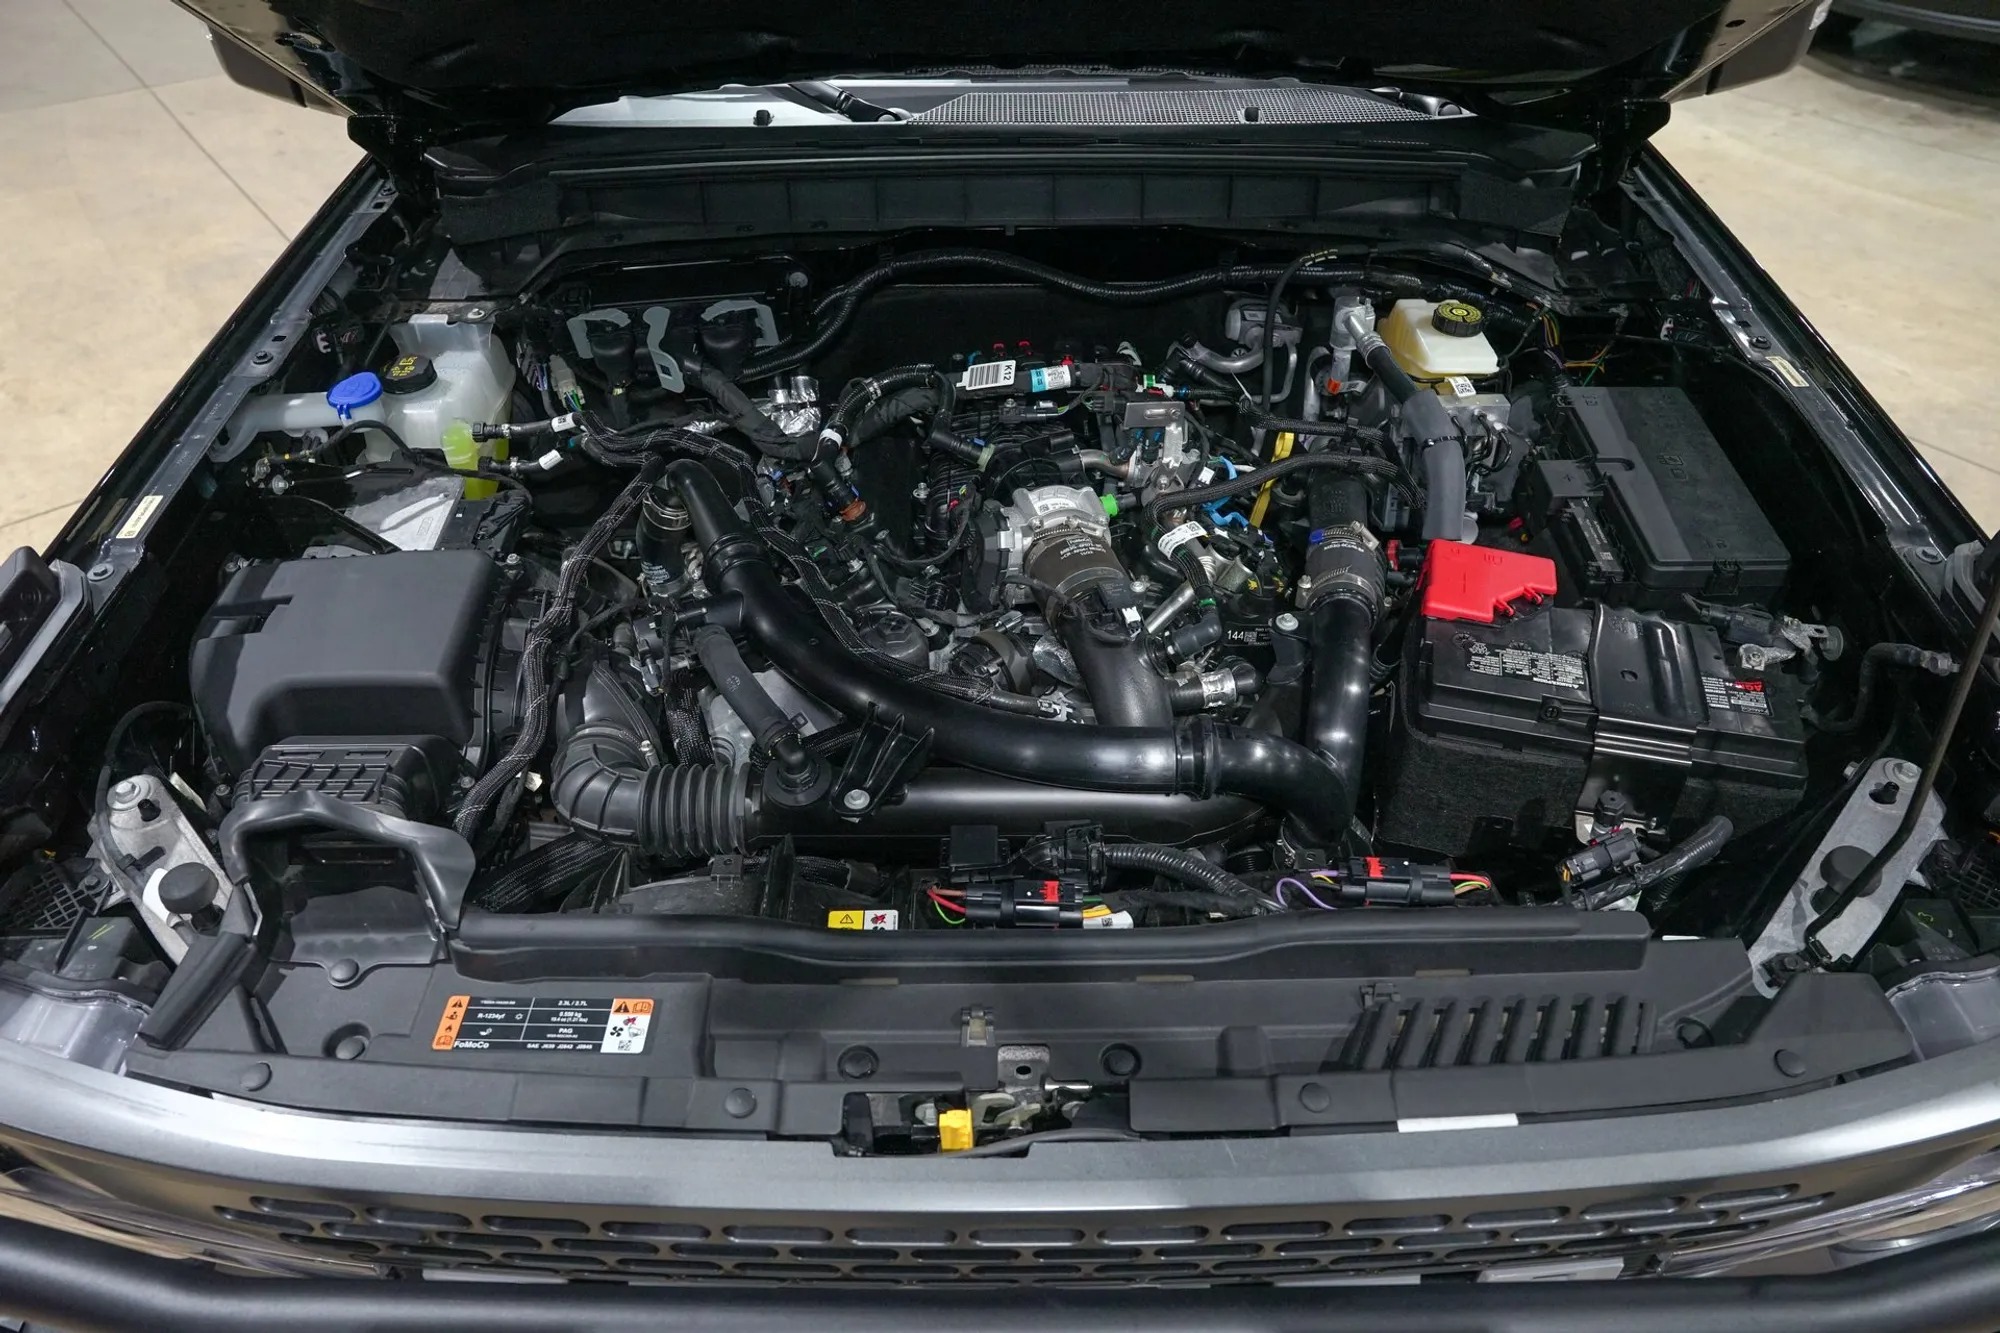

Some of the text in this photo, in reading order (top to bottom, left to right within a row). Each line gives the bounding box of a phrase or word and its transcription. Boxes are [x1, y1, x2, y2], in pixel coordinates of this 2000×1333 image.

[1003, 364, 1013, 381] K12
[1227, 630, 1244, 640] 144
[477, 1012, 505, 1020] R-1234yf
[454, 1040, 489, 1049] FoMoCo
